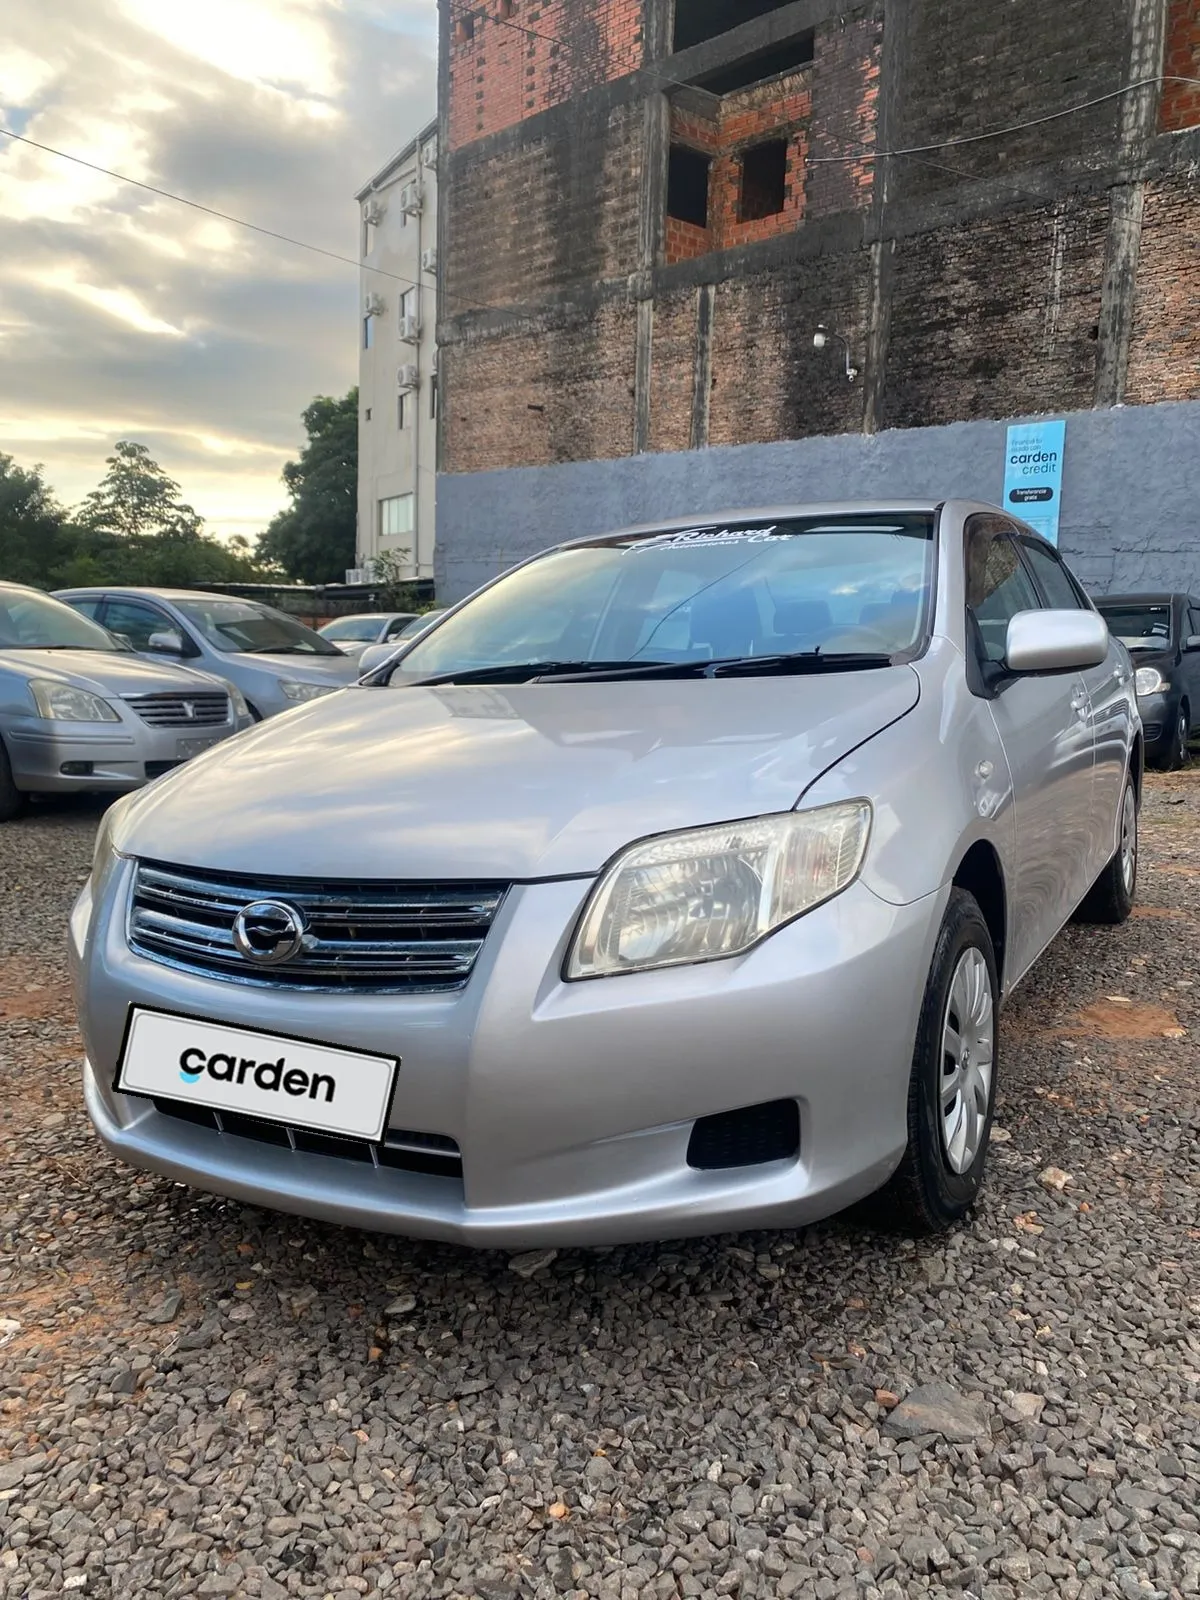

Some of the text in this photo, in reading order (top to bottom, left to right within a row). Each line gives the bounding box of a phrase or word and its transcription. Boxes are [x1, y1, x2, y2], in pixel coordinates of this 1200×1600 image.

[1010, 451, 1057, 465] carden
[1022, 463, 1056, 475] credit
[671, 525, 793, 543] Richard Car
